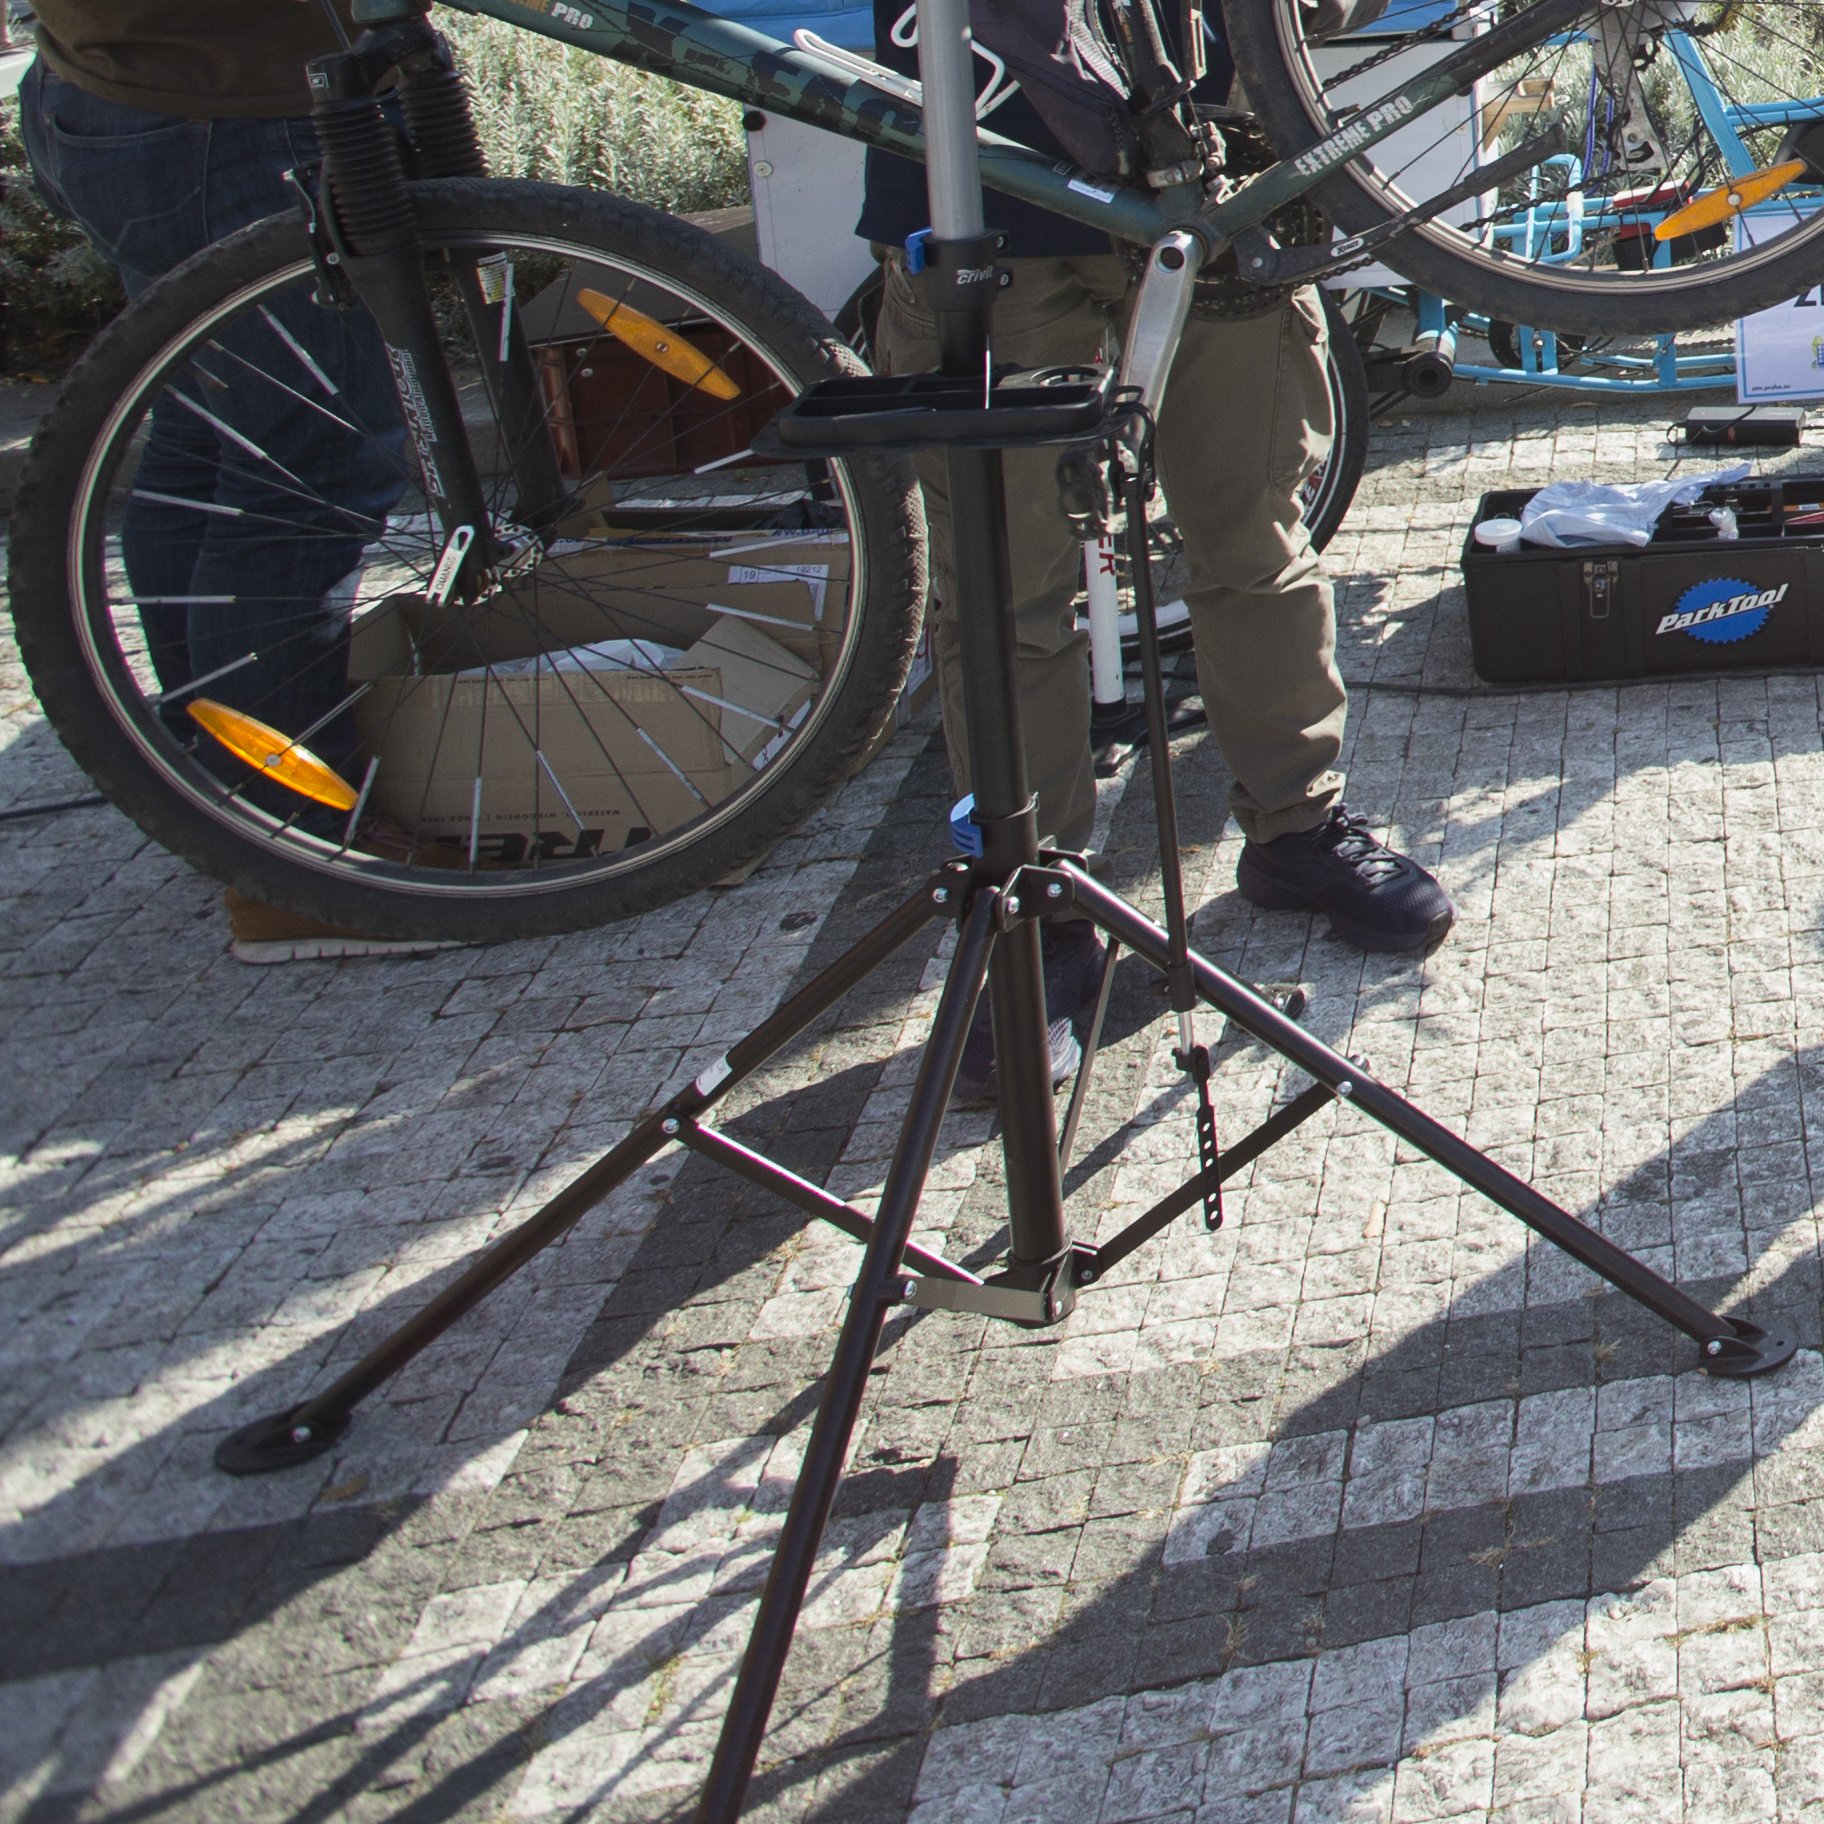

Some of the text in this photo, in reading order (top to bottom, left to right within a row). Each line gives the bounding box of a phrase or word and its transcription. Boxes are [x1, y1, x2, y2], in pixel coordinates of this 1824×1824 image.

[550, 2, 594, 30] PRO
[1293, 95, 1415, 177] EXTREME PRO
[742, 569, 757, 580] 19
